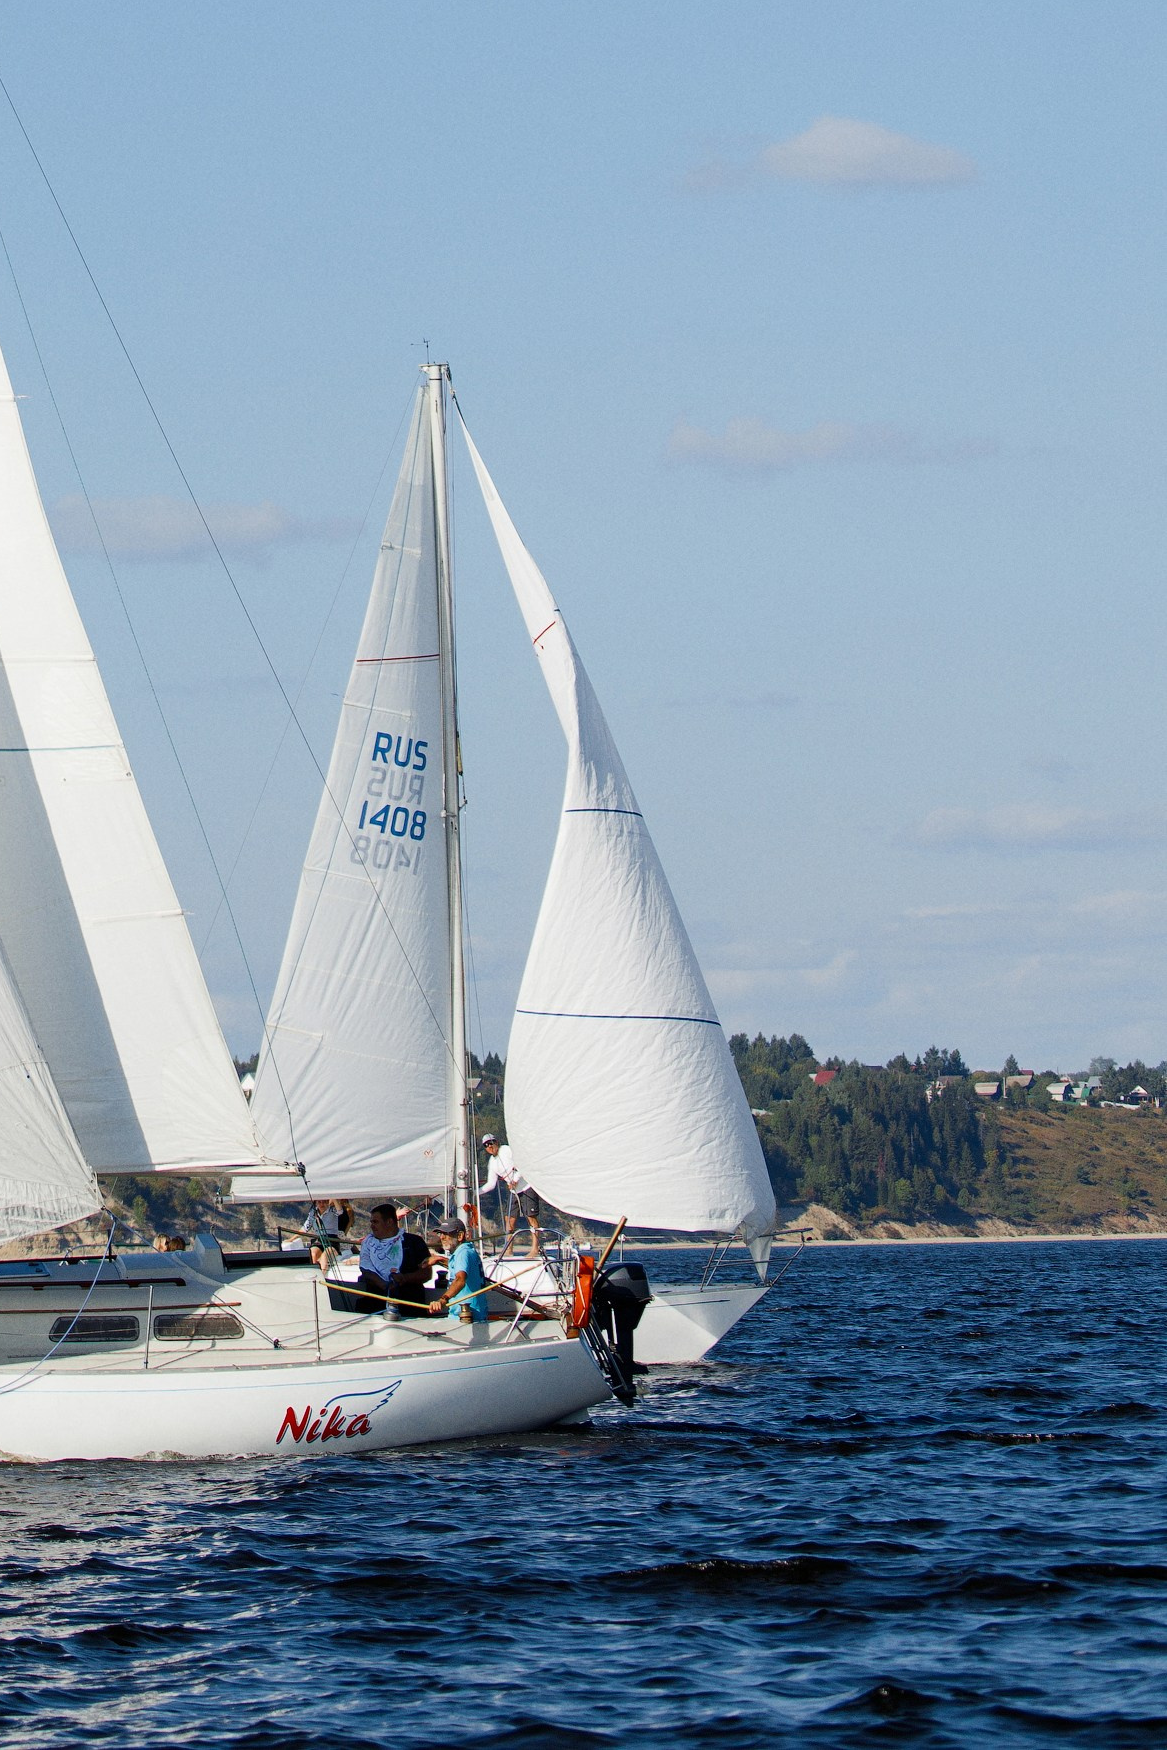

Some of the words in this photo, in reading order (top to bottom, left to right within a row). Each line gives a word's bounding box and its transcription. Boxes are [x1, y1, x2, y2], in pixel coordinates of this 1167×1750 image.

[371, 731, 428, 771] RUS
[358, 800, 427, 841] 1408
[275, 1405, 373, 1445] Nika
